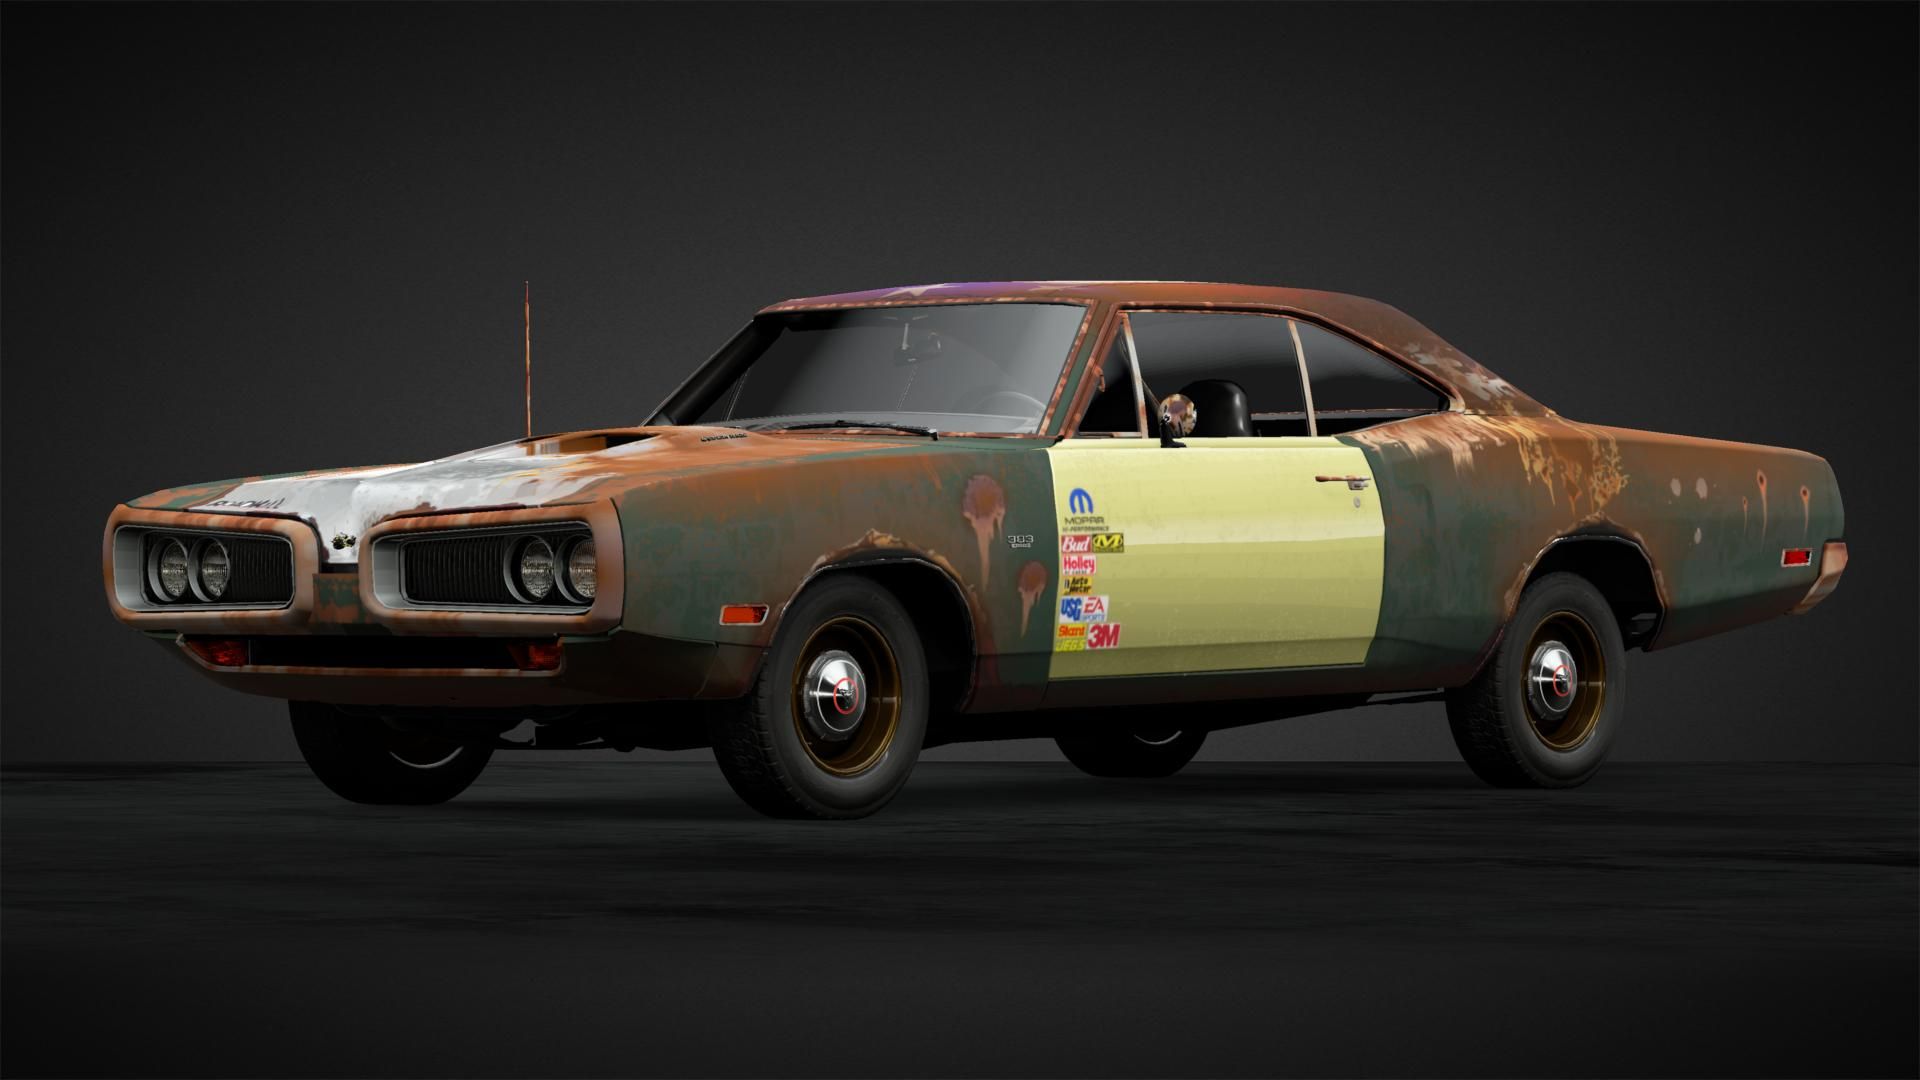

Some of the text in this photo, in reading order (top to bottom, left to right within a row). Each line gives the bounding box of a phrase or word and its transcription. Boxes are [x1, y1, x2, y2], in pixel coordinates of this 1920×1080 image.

[1064, 516, 1104, 525] MOPAR
[1062, 536, 1090, 552] Bud
[1063, 557, 1095, 572] Holley
[1084, 597, 1105, 613] EA
[1088, 624, 1120, 649] 3M
